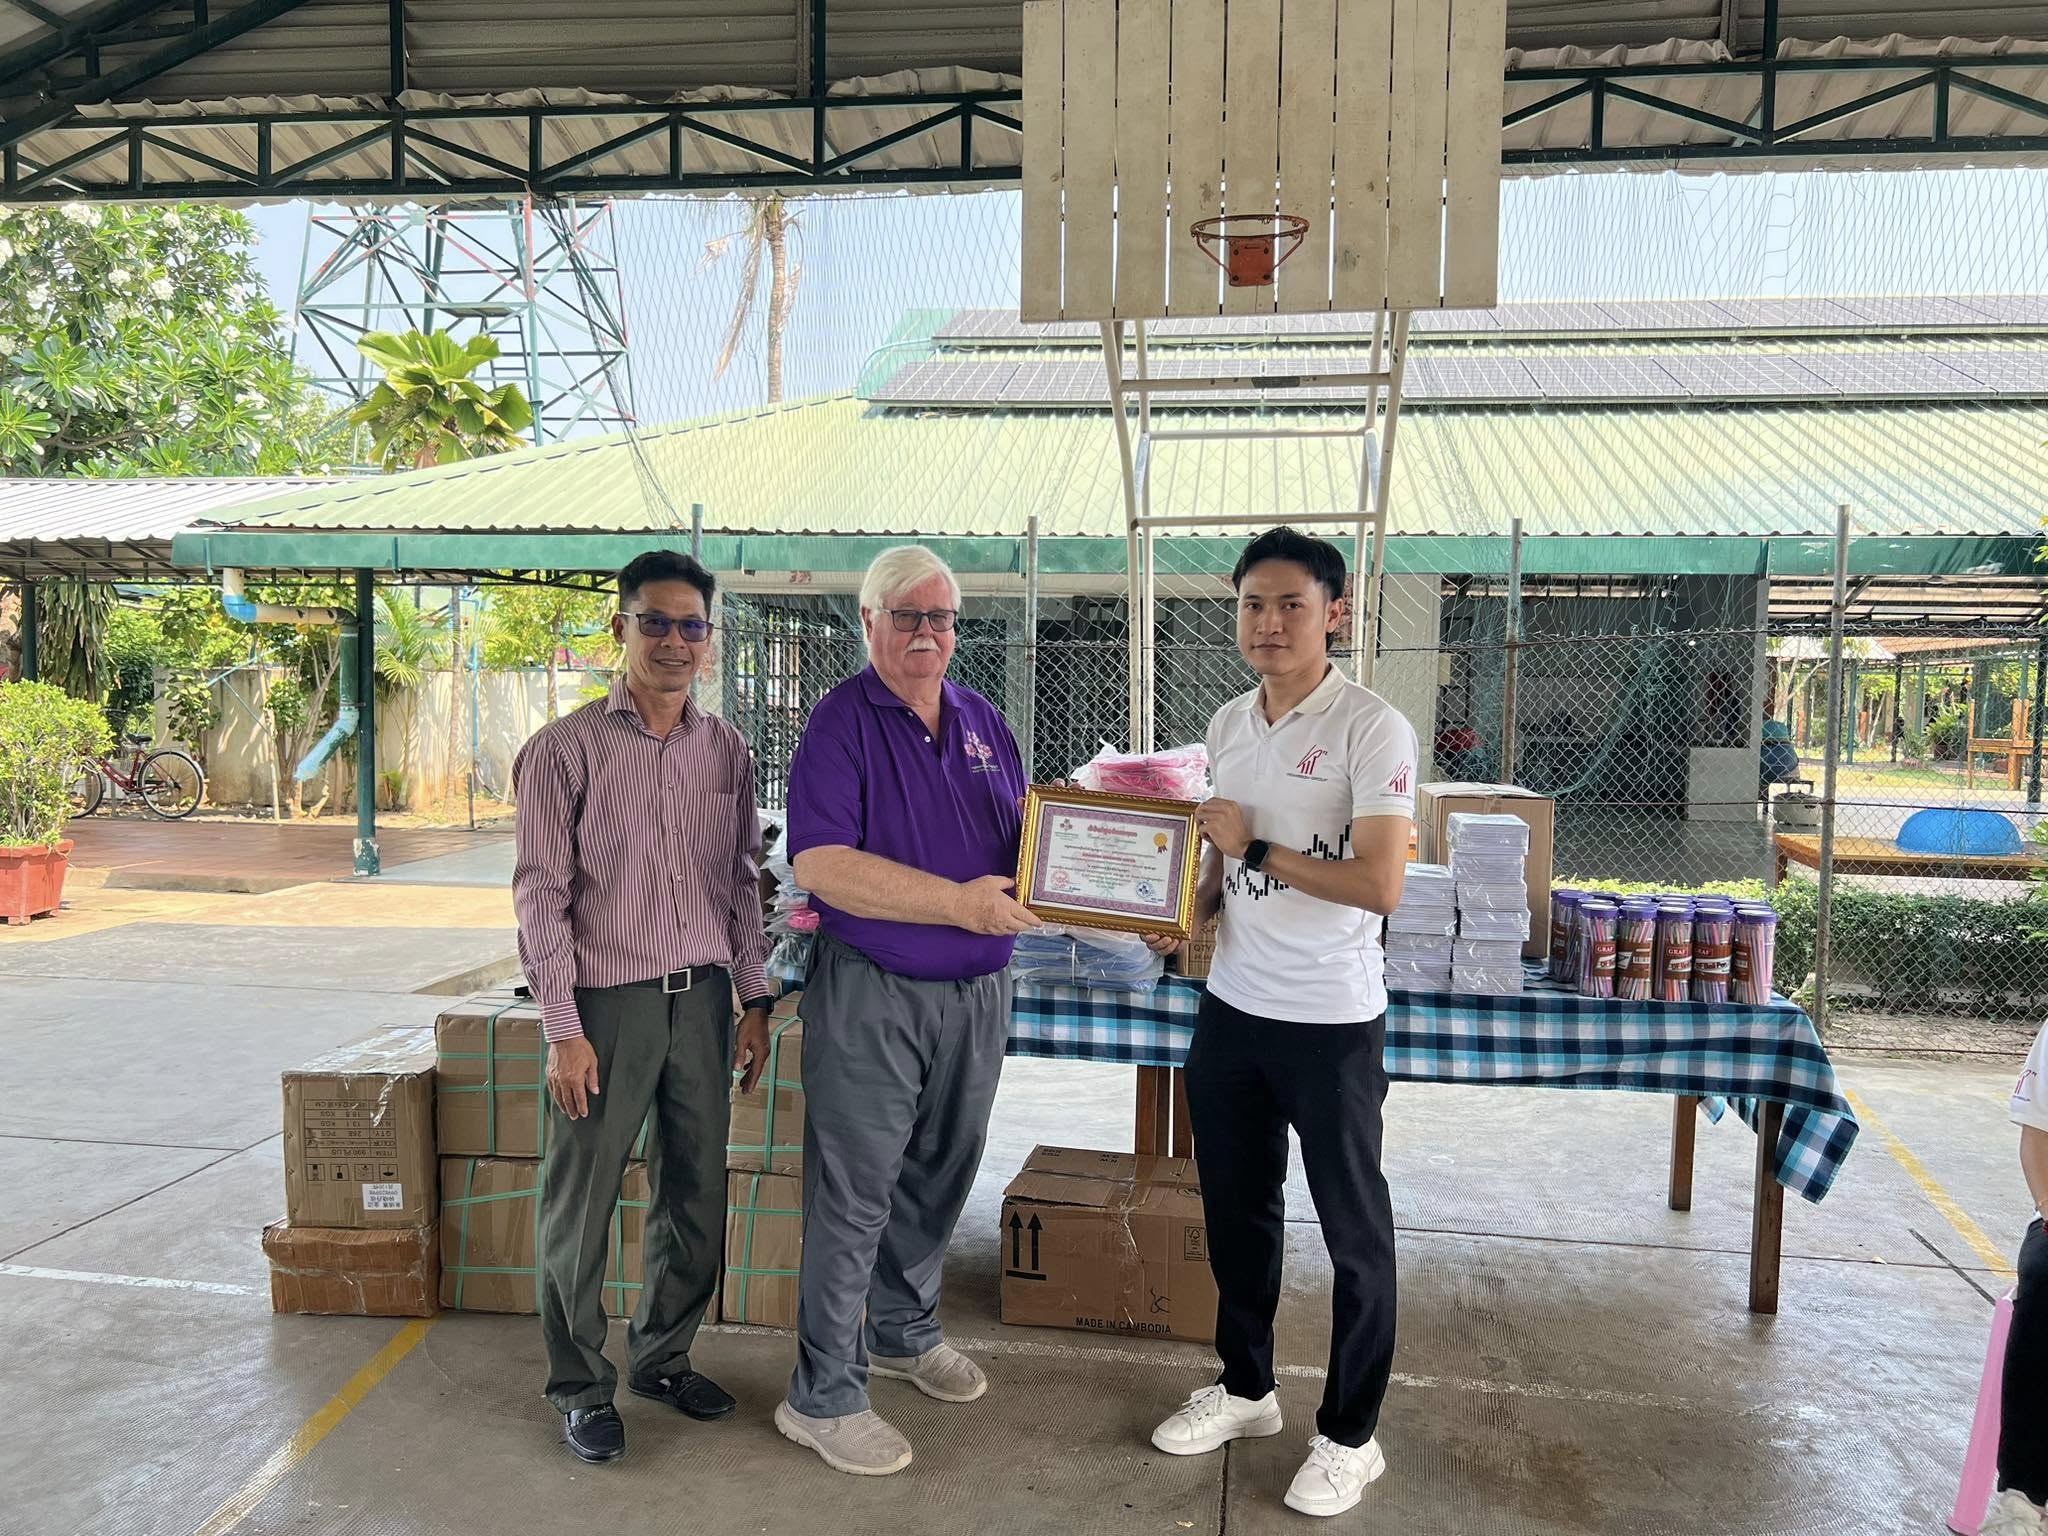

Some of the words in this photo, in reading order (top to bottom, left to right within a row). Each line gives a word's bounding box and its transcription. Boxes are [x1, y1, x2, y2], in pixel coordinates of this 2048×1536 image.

[1076, 1317, 1104, 1329] MADE
[1106, 1319, 1116, 1329] IN
[1119, 1321, 1172, 1335] CAMBODIA
